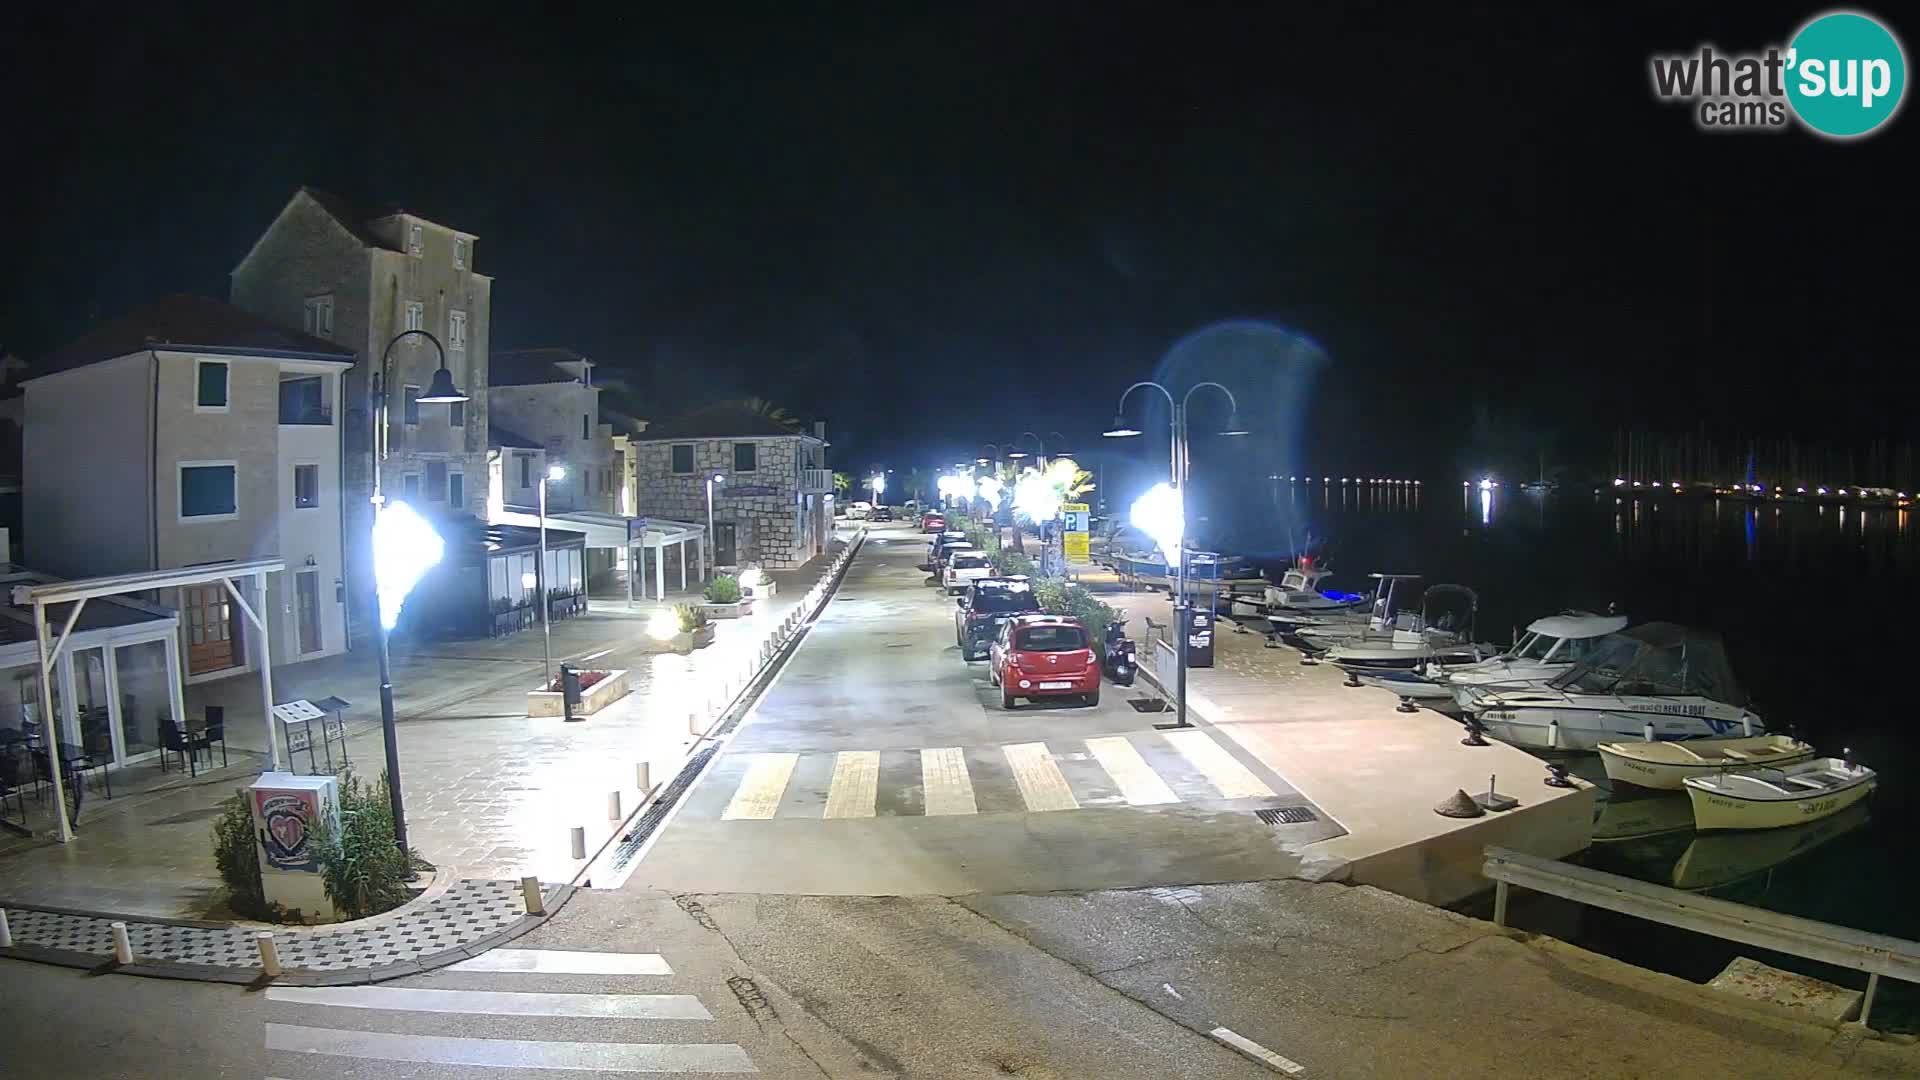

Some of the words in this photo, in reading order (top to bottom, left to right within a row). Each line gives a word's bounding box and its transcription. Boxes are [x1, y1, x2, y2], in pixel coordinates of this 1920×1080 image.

[1065, 514, 1076, 530] P
[1664, 704, 1681, 714] RENT
[1688, 705, 1706, 716] BOAT
